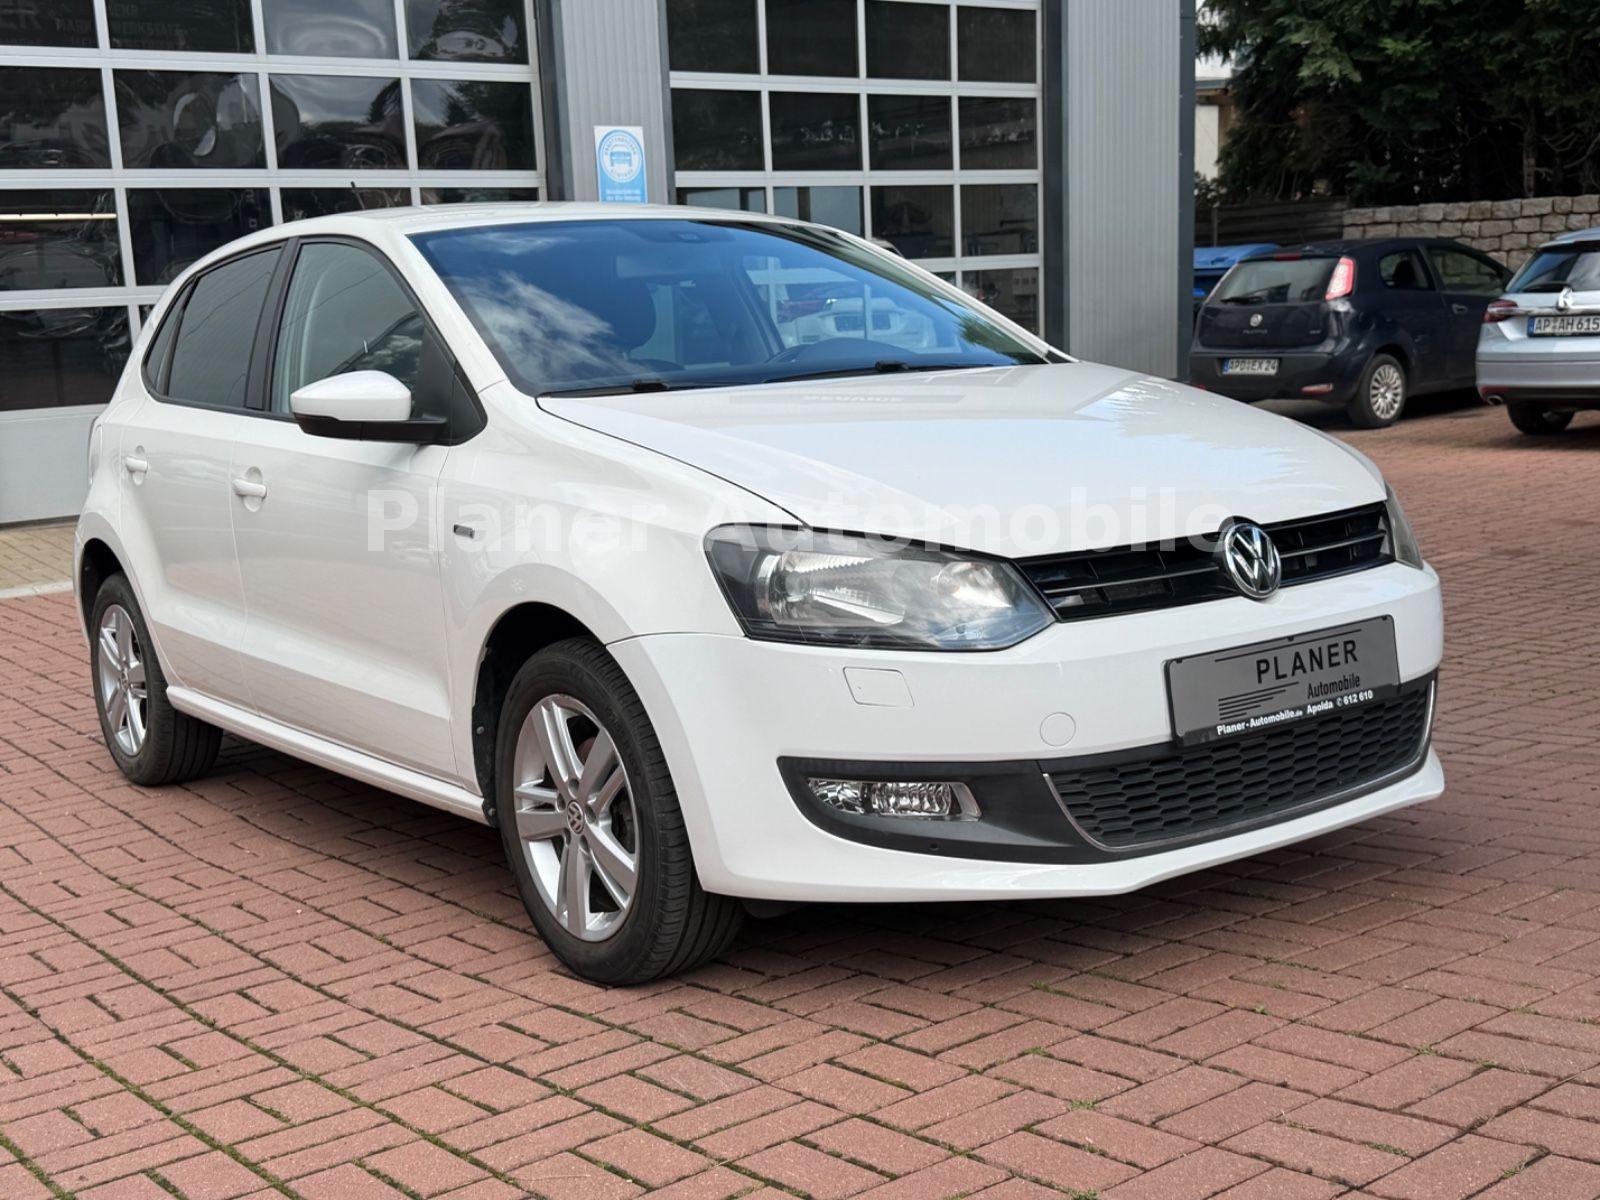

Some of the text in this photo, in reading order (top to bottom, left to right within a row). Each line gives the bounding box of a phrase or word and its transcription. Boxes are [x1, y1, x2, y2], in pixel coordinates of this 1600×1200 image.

[1535, 318, 1551, 331] AP
[1576, 316, 1600, 330] 615
[1256, 639, 1360, 684] PLANER
[1307, 673, 1360, 699] Automobile
[1306, 700, 1334, 715] Apolda
[1343, 693, 1358, 705] 612
[1358, 689, 1374, 702] 610
